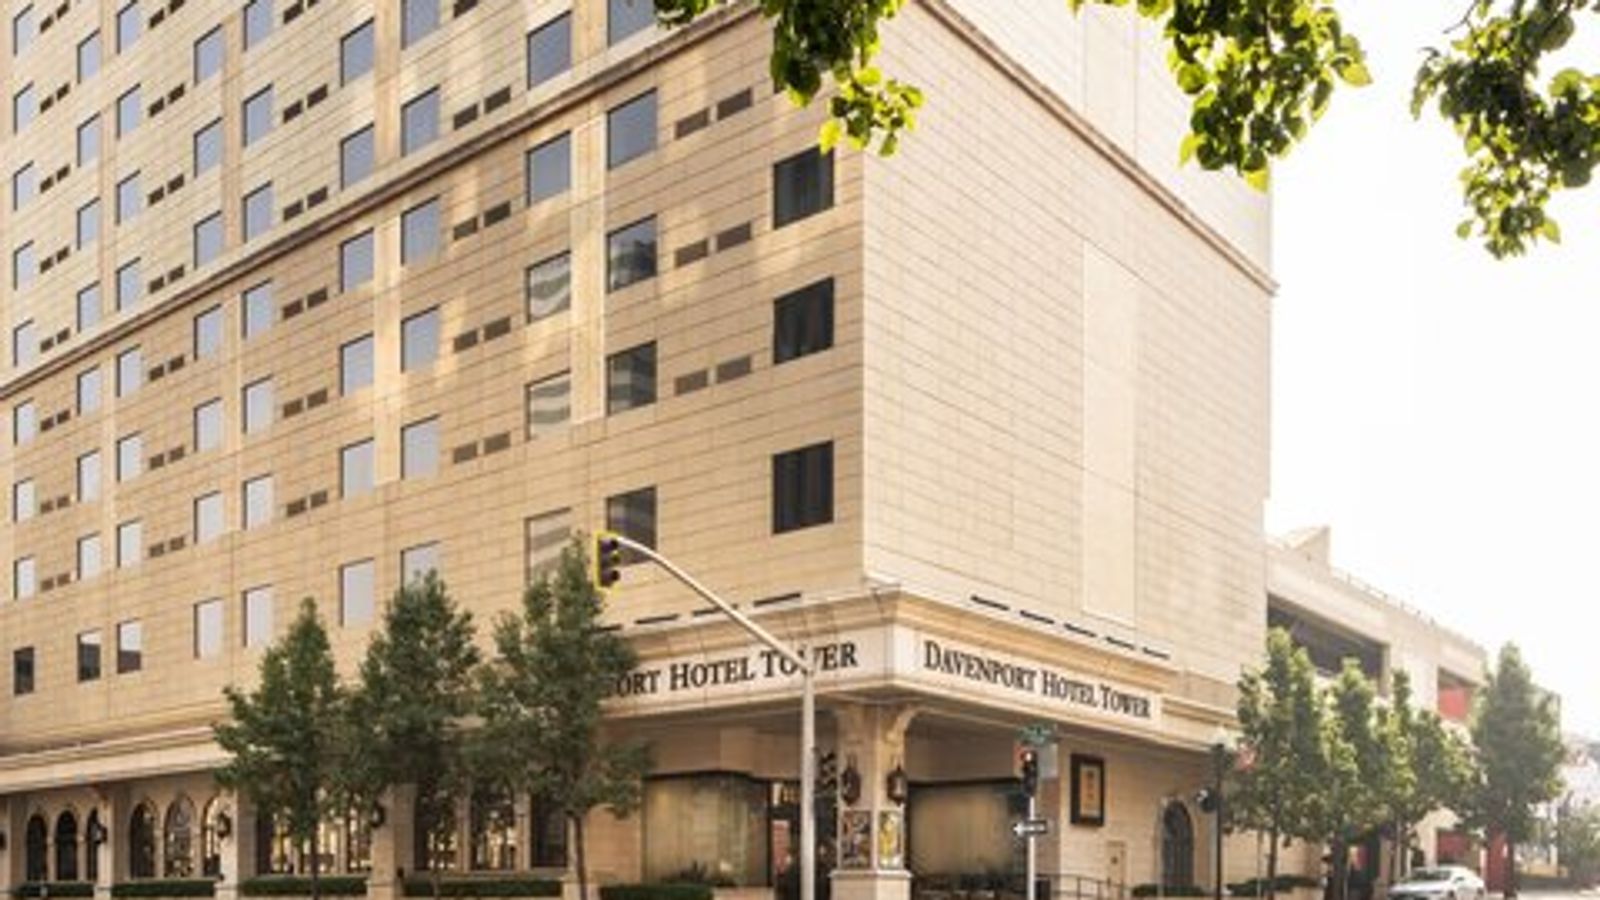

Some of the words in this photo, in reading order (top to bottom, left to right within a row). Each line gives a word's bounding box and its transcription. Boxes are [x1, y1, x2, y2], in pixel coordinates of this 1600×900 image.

[606, 670, 661, 698] ORT
[668, 656, 755, 691] HOTEL
[923, 640, 1036, 692] DAVENPORT
[1040, 670, 1098, 707] HOTEL
[1100, 685, 1151, 718] TOWER
